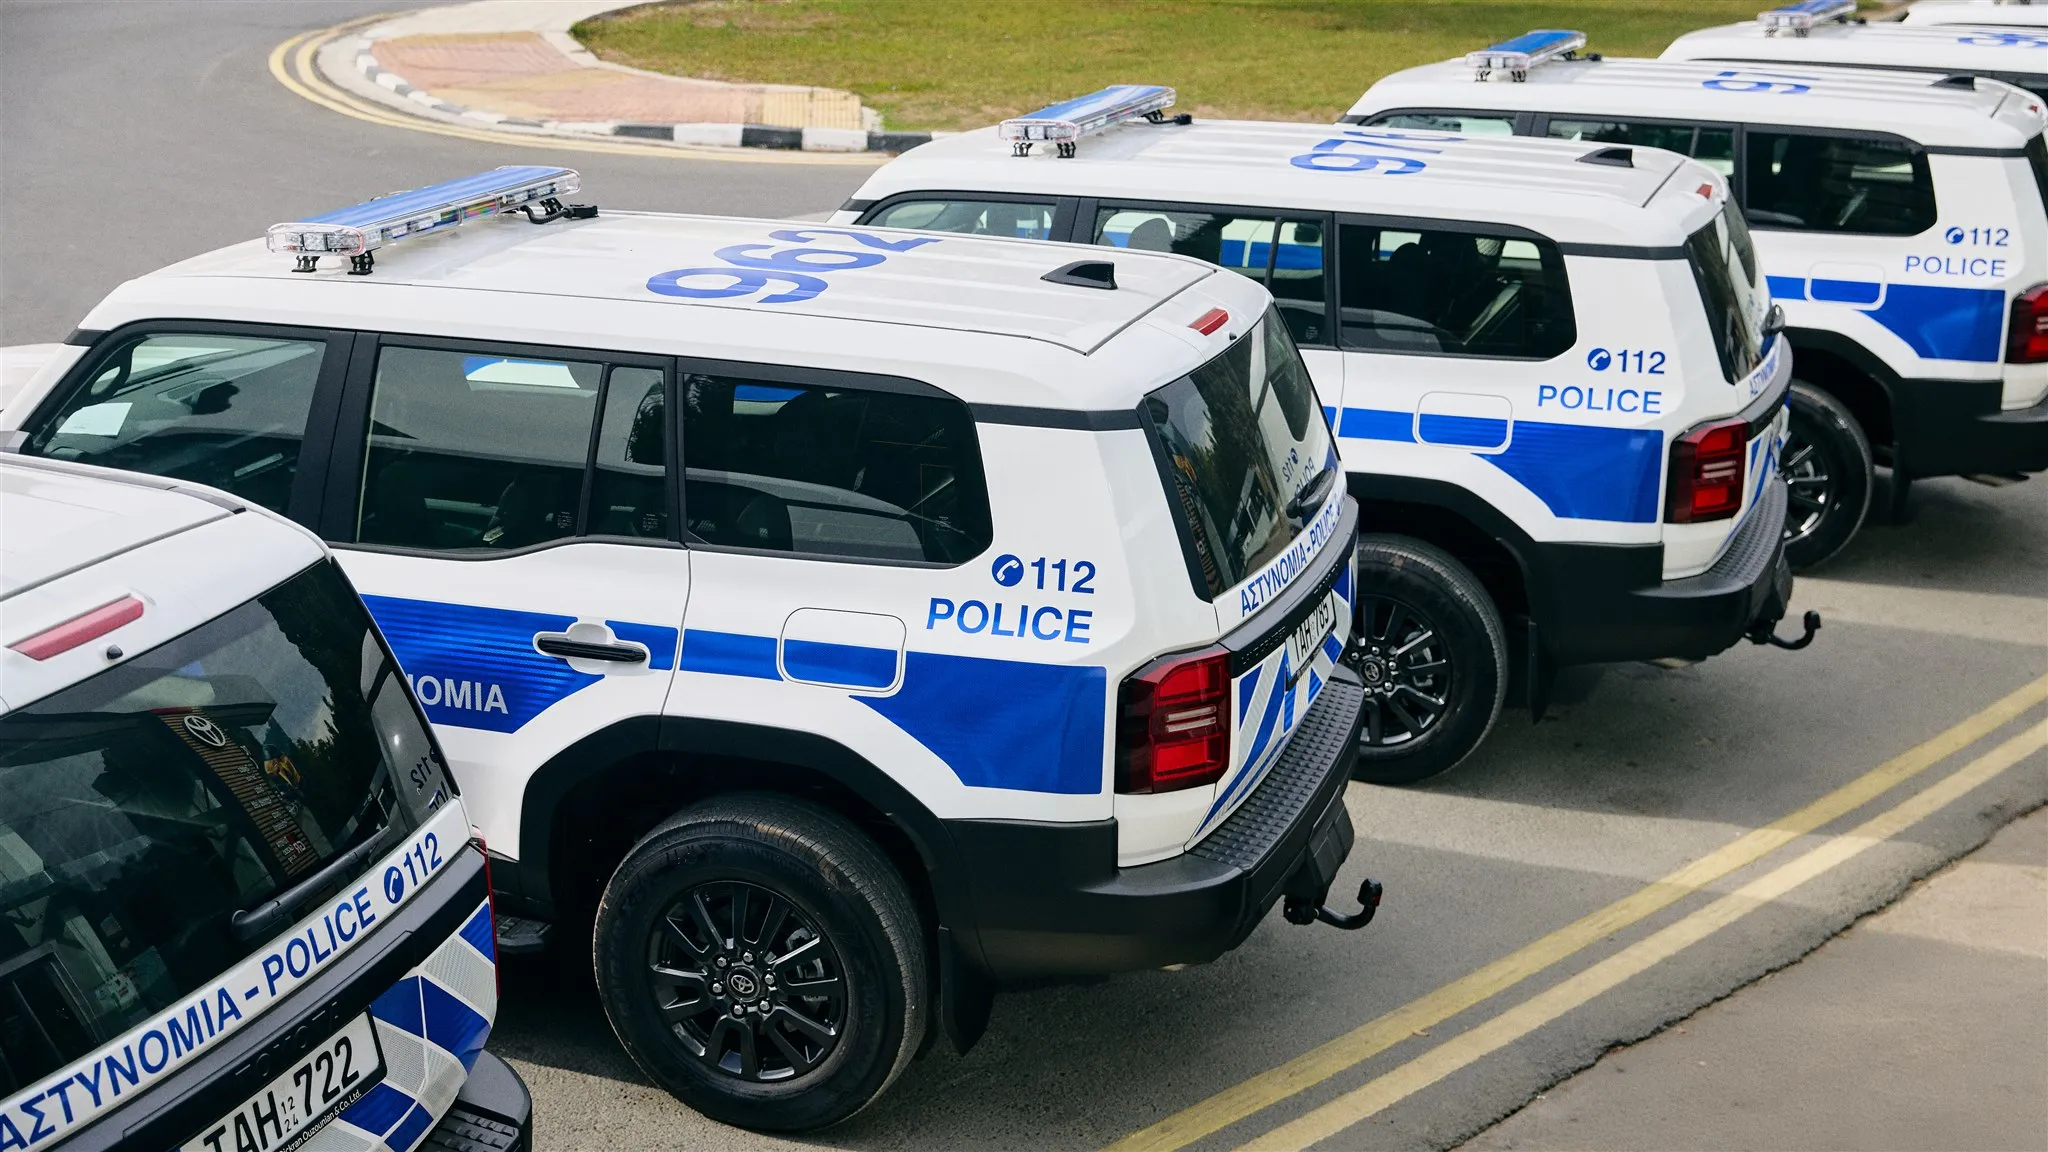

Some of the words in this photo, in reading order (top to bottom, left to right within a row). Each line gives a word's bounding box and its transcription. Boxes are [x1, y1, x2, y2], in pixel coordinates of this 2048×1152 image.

[1970, 228, 2009, 246] 112
[646, 230, 943, 303] 962
[1905, 256, 2006, 277] POLICE
[1618, 349, 1666, 375] 112
[1537, 384, 1662, 414] POLICE
[1031, 557, 1096, 594] 112
[926, 597, 1093, 643] POLICE
[0, 987, 242, 1150] ΑΣΤΥΝΟΜΙΑ
[262, 887, 376, 997] POLICE
[404, 832, 442, 887] 112
[293, 1036, 360, 1117] 722
[280, 1096, 295, 1114] 12
[284, 1114, 299, 1133] 24
[302, 1113, 335, 1140] Ouzounian
